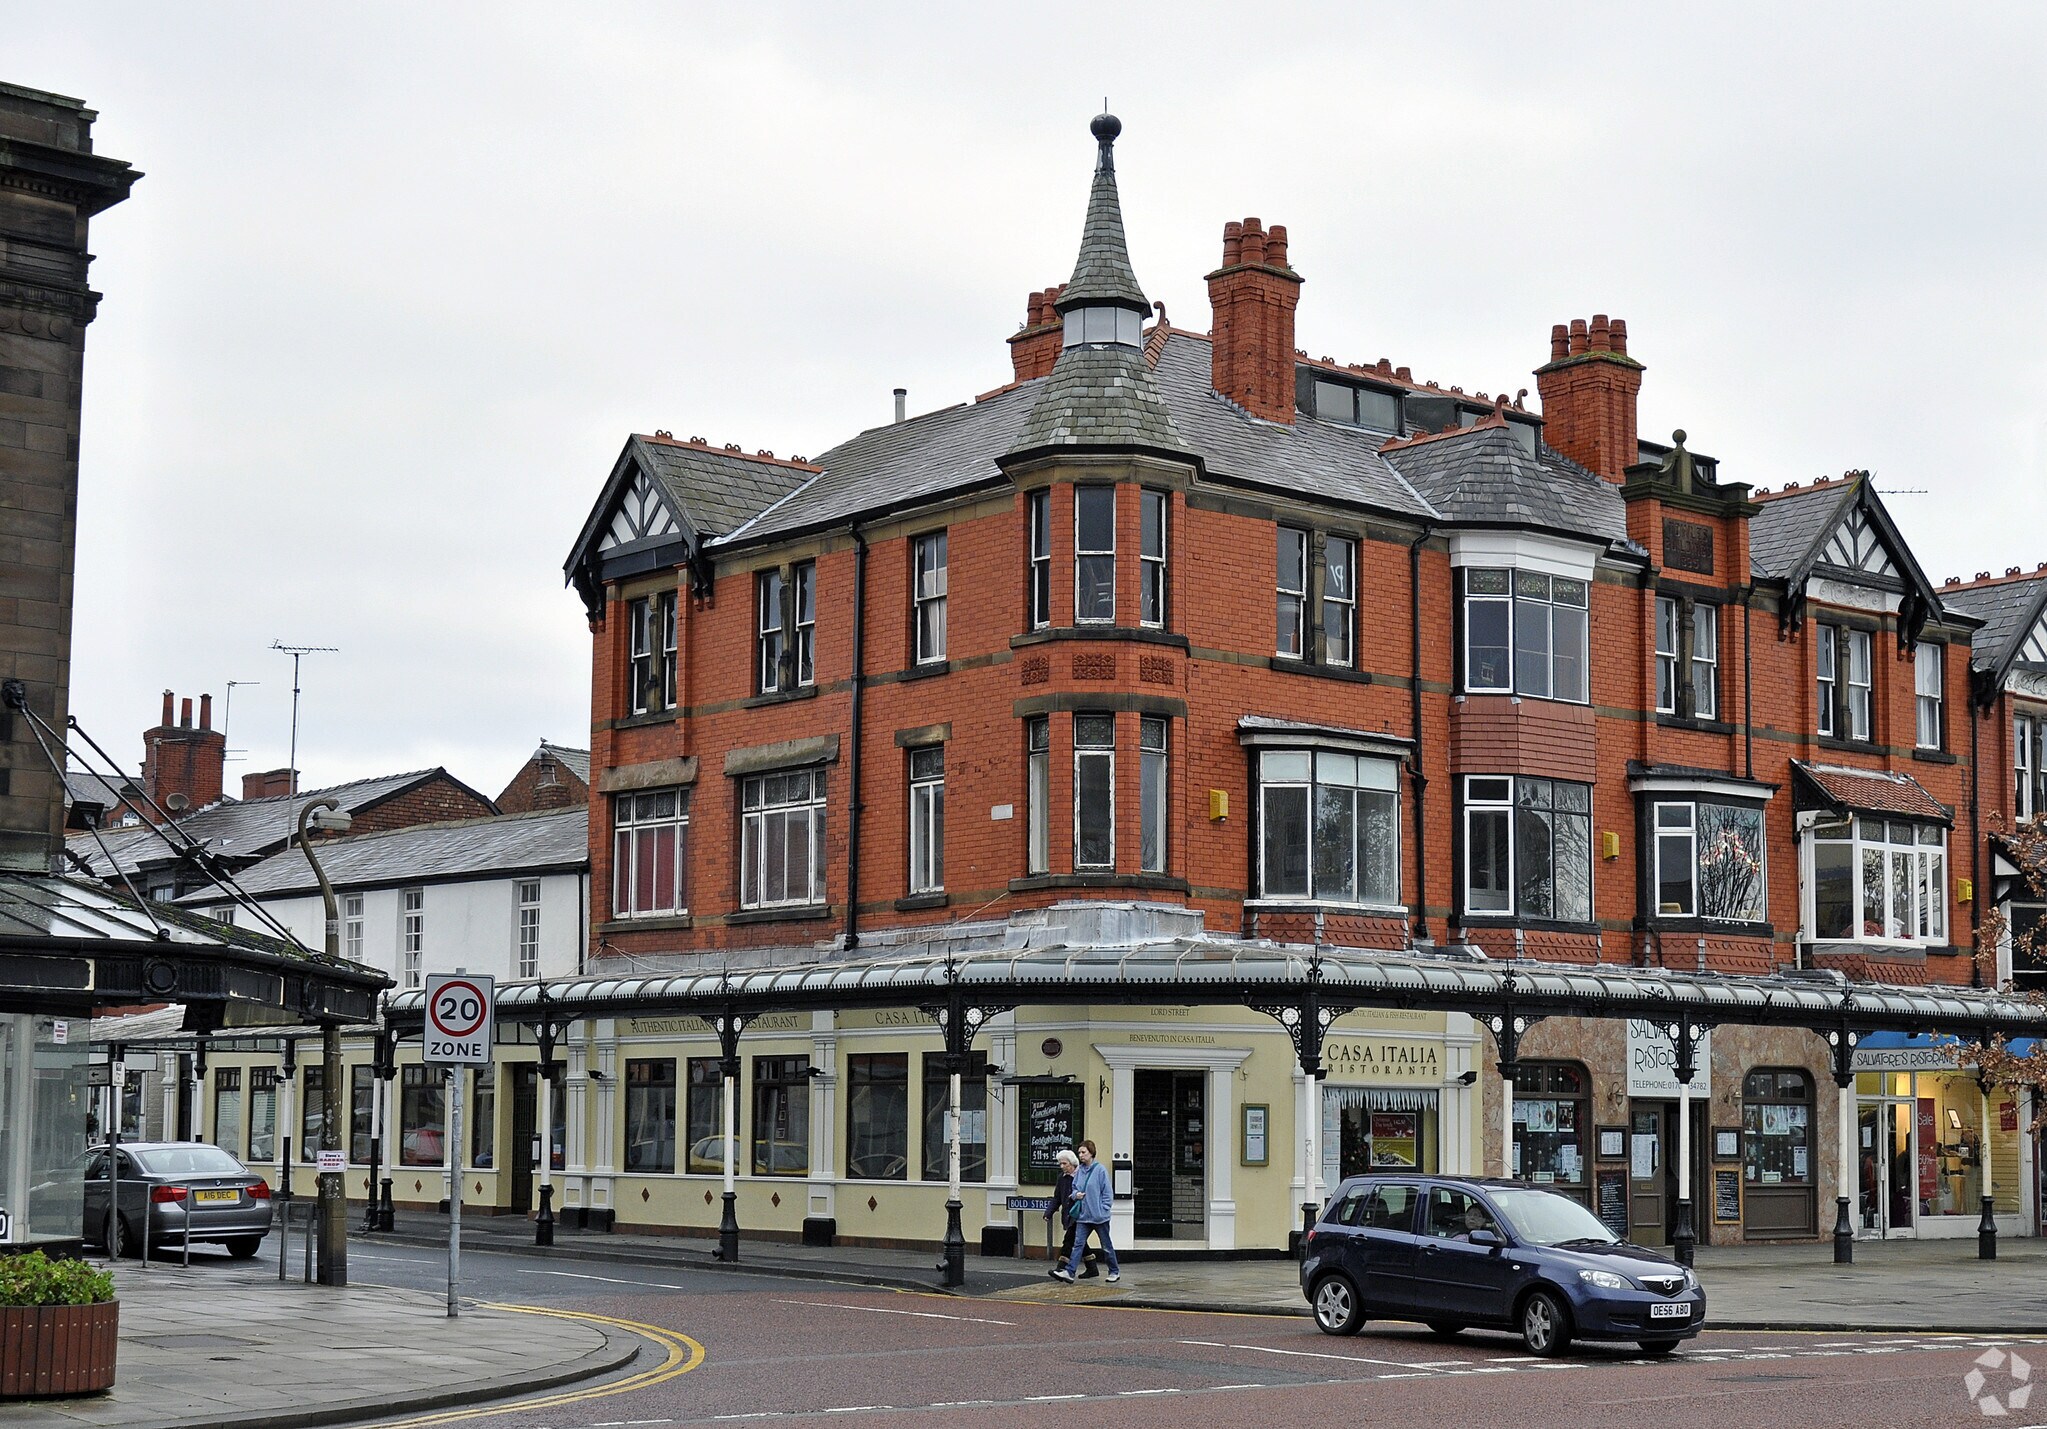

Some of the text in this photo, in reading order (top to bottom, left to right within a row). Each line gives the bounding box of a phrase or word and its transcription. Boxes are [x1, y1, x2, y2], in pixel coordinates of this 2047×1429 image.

[440, 997, 480, 1021] 20
[1150, 1008, 1190, 1017] LORD STREET
[745, 1015, 799, 1029] ESTAURANT
[875, 1010, 936, 1025] CASA ITA
[632, 1019, 678, 1033] AUTHENTIC
[1129, 1034, 1216, 1044] BENEVENUTO IN CASA ITALIA
[430, 1042, 482, 1057] ZONE
[1327, 1043, 1437, 1064] CASA ITALIA
[1328, 1063, 1438, 1076] RISTORANTE
[1918, 1112, 1934, 1126] Sale
[217, 1190, 232, 1199] DEC
[1010, 1199, 1028, 1208] BOLD
[1653, 1305, 1673, 1316] OE56
